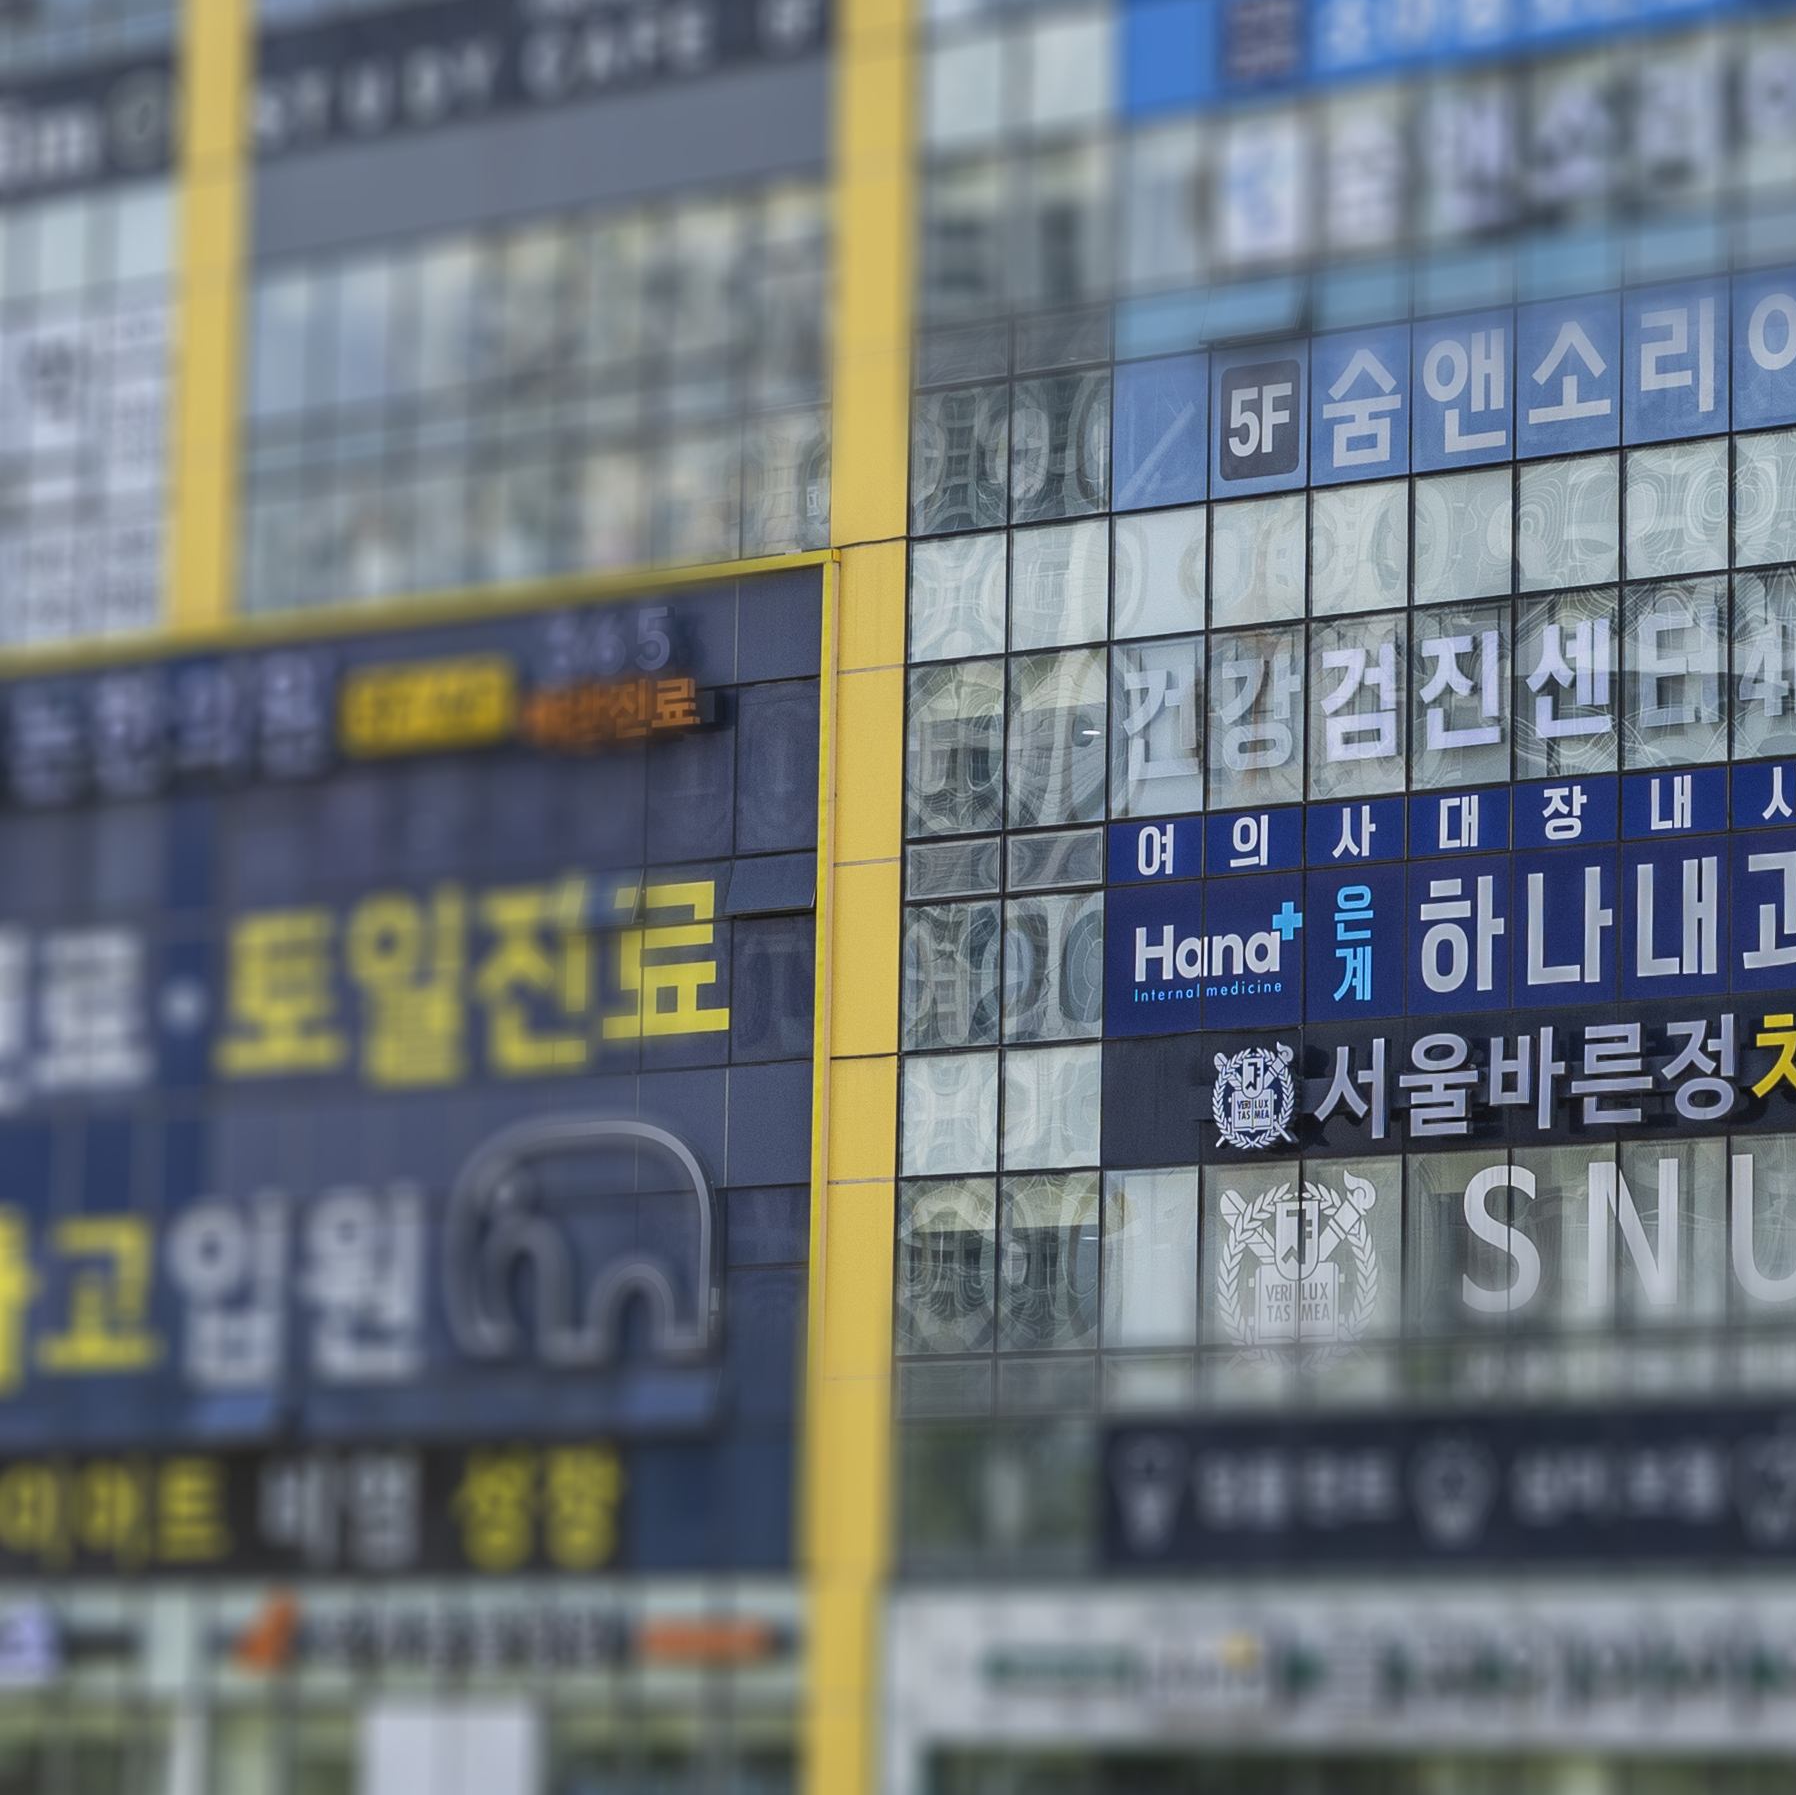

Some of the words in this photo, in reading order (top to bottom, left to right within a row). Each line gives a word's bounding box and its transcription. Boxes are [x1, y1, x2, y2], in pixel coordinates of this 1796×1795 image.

[1228, 381, 1292, 458] 5F
[1134, 925, 1282, 983] Hana
[1333, 884, 1375, 1002] 은계
[1134, 986, 1201, 1003] Internal
[1206, 979, 1283, 999] medicine
[1300, 1282, 1329, 1301] LUX
[1266, 1304, 1292, 1323] TAS
[1300, 1302, 1331, 1322] MEA
